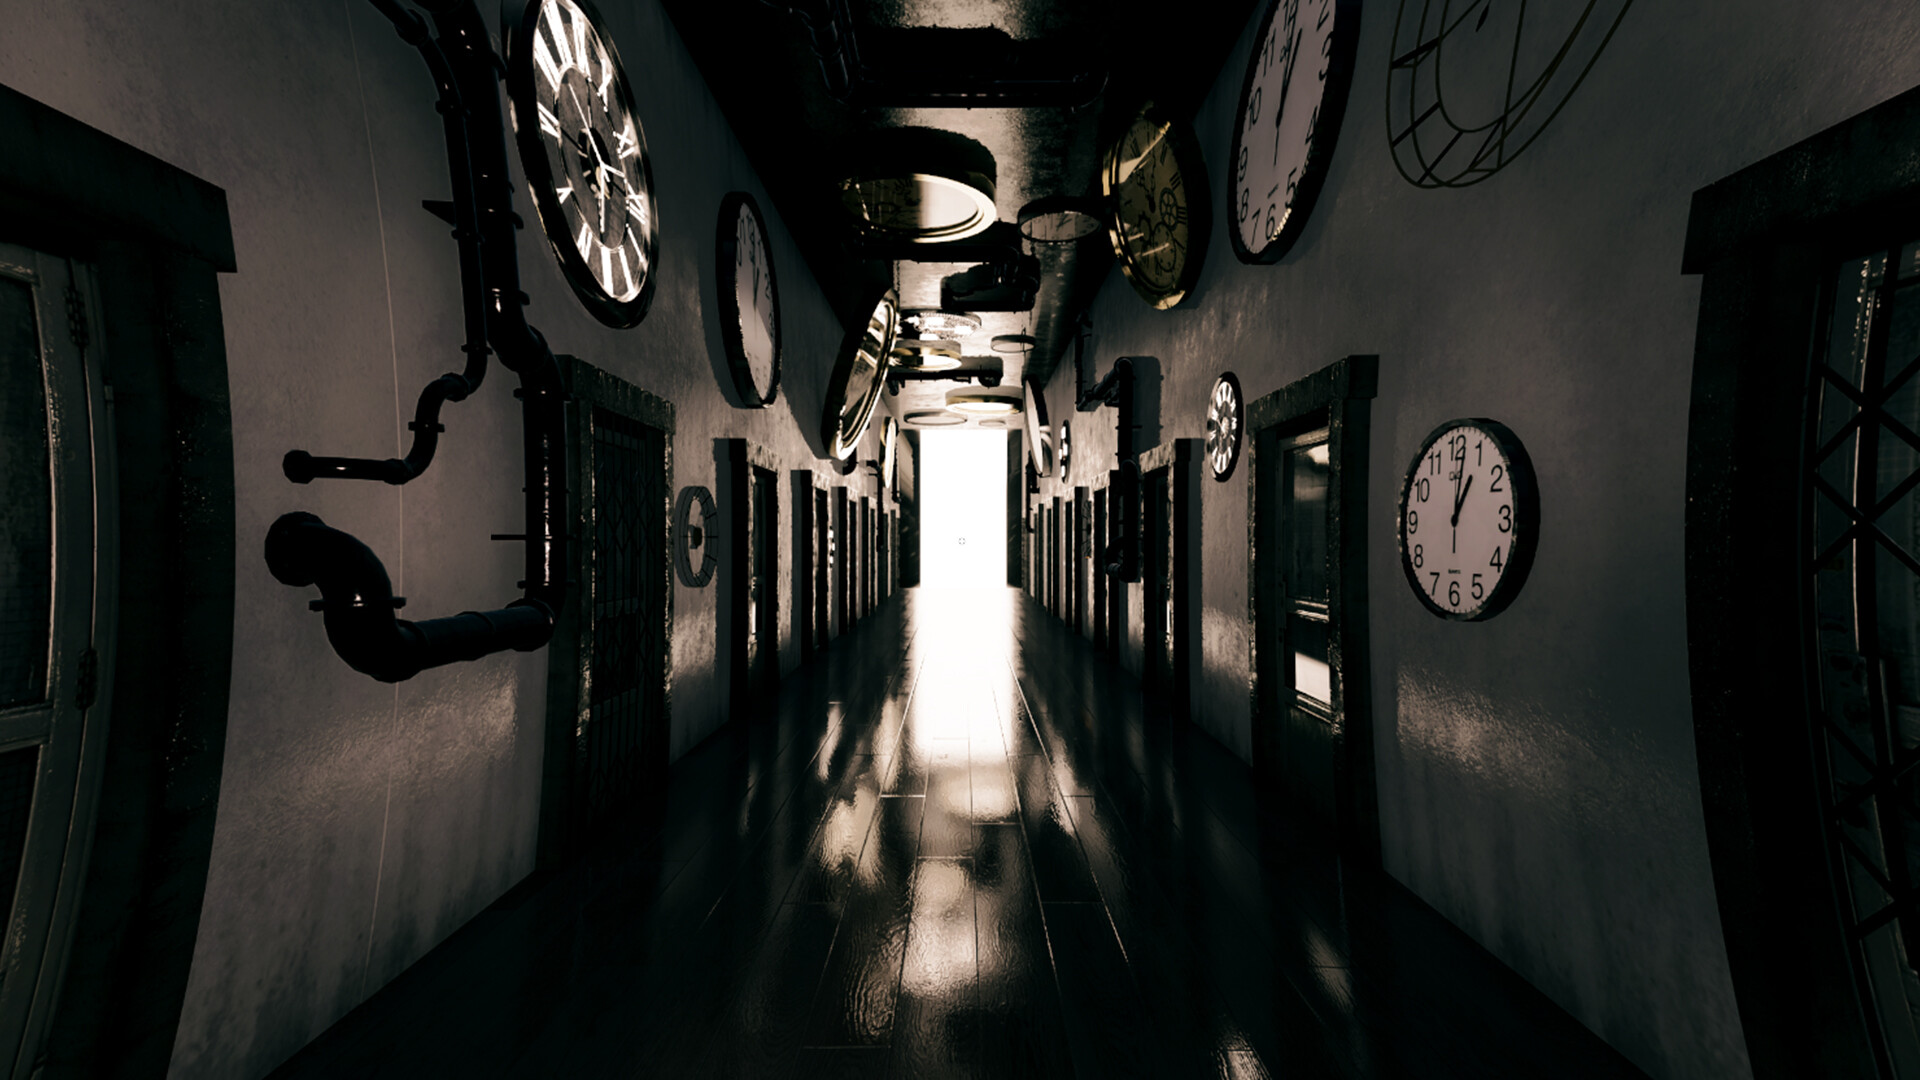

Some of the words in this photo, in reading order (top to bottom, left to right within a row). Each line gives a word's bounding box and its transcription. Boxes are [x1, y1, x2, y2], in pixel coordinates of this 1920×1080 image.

[1239, 146, 1248, 182] 9
[1240, 187, 1249, 223] 8
[1251, 208, 1261, 248] 7
[1265, 203, 1276, 240] 6
[1448, 434, 1466, 461] 12
[1475, 440, 1482, 467] 1
[1427, 450, 1441, 476] 11
[1414, 478, 1430, 502] 10
[1490, 464, 1503, 493] 2
[1408, 510, 1418, 534] 9
[1498, 504, 1511, 533] 3
[1414, 544, 1424, 568] 8
[1489, 545, 1503, 573] 4
[1429, 572, 1440, 596] 7
[1448, 581, 1460, 607] 6
[1471, 573, 1483, 599] 5
